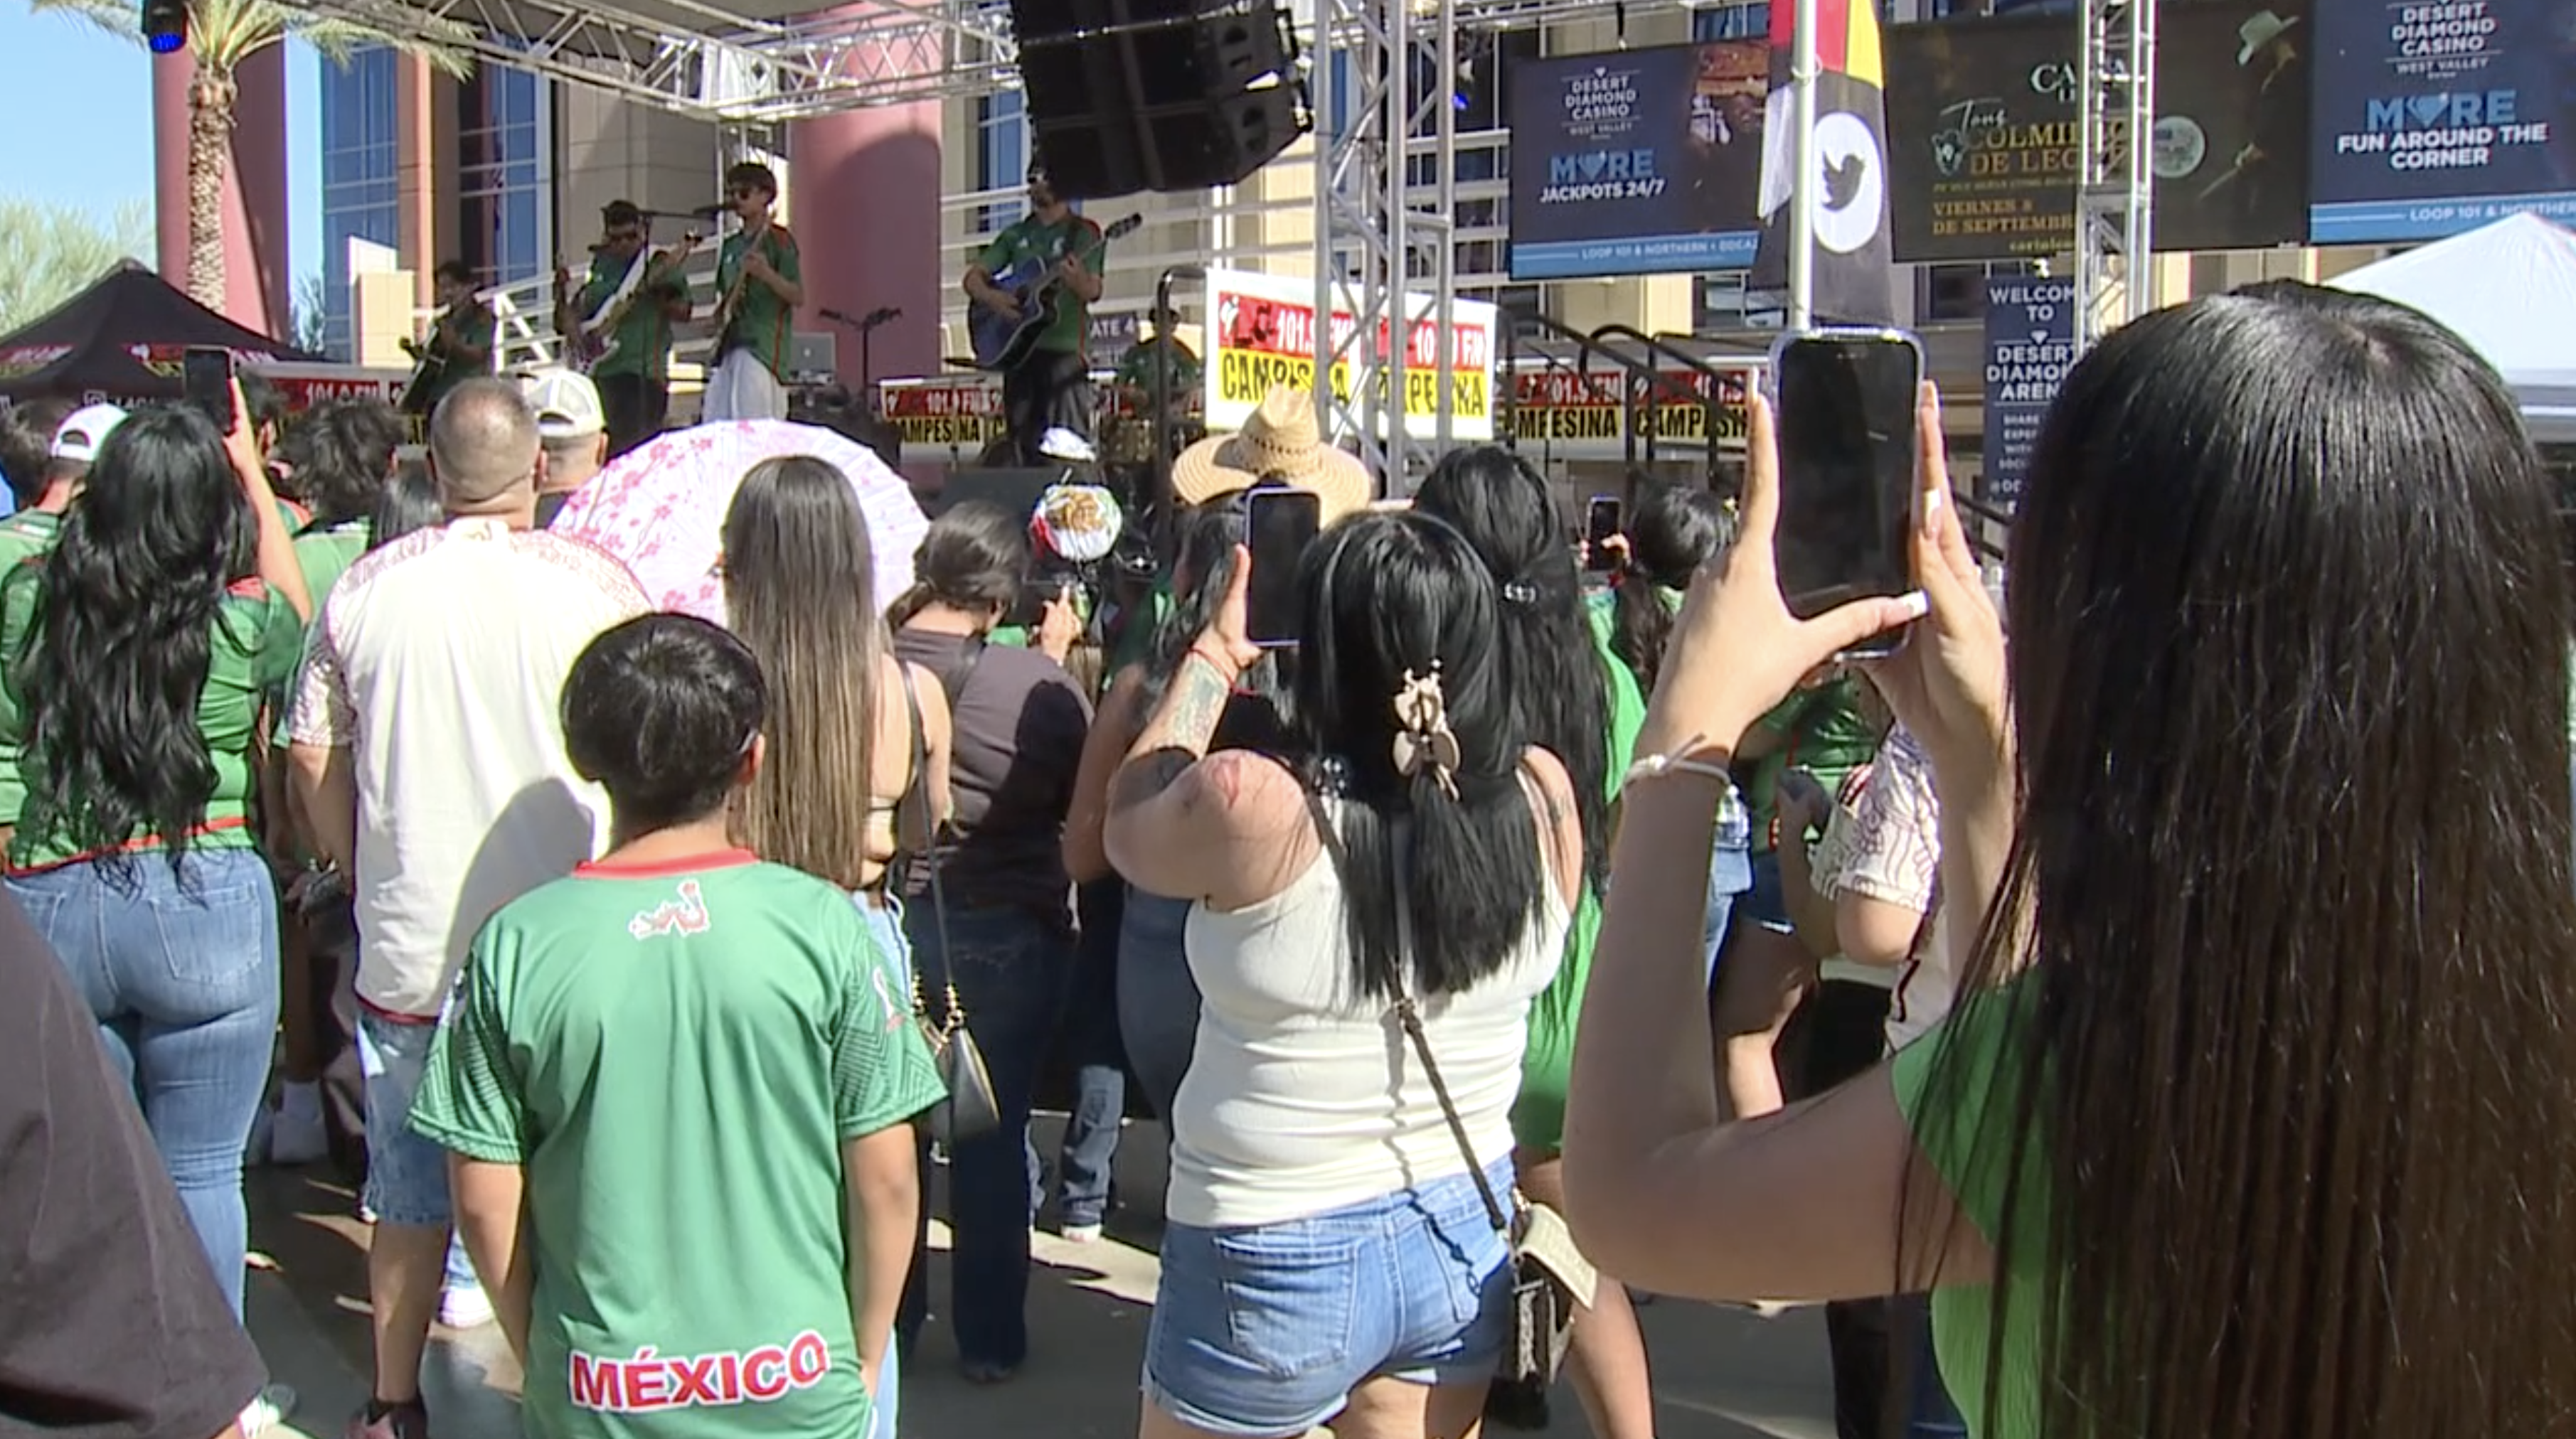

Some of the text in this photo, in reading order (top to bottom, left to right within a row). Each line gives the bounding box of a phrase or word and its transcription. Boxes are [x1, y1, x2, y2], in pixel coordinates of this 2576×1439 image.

[2402, 2, 2486, 23] DESERT
[2391, 18, 2496, 41] DIAMOND
[2401, 35, 2485, 55] CASINO
[2397, 57, 2489, 74] WEST VALLEY
[1571, 75, 1629, 93] DESERT
[1565, 89, 1636, 108] DIAMOND
[1572, 104, 1629, 120] CASINO
[2338, 123, 2549, 154] FUN AROUND THE
[1970, 146, 2078, 175] DE LEC
[2390, 147, 2490, 169] CORNER
[1540, 177, 1665, 203] JACKPOTS 24/7
[1962, 214, 2075, 234] SEPTIEMBR
[2410, 207, 2454, 222] LOOP
[1582, 246, 1614, 260] LOOP
[1989, 286, 2075, 305] WELCOM
[2026, 306, 2054, 321] TO
[1090, 319, 1121, 338] ATE
[2000, 382, 2060, 400] AREN
[570, 1330, 831, 1412] MÉXICO
